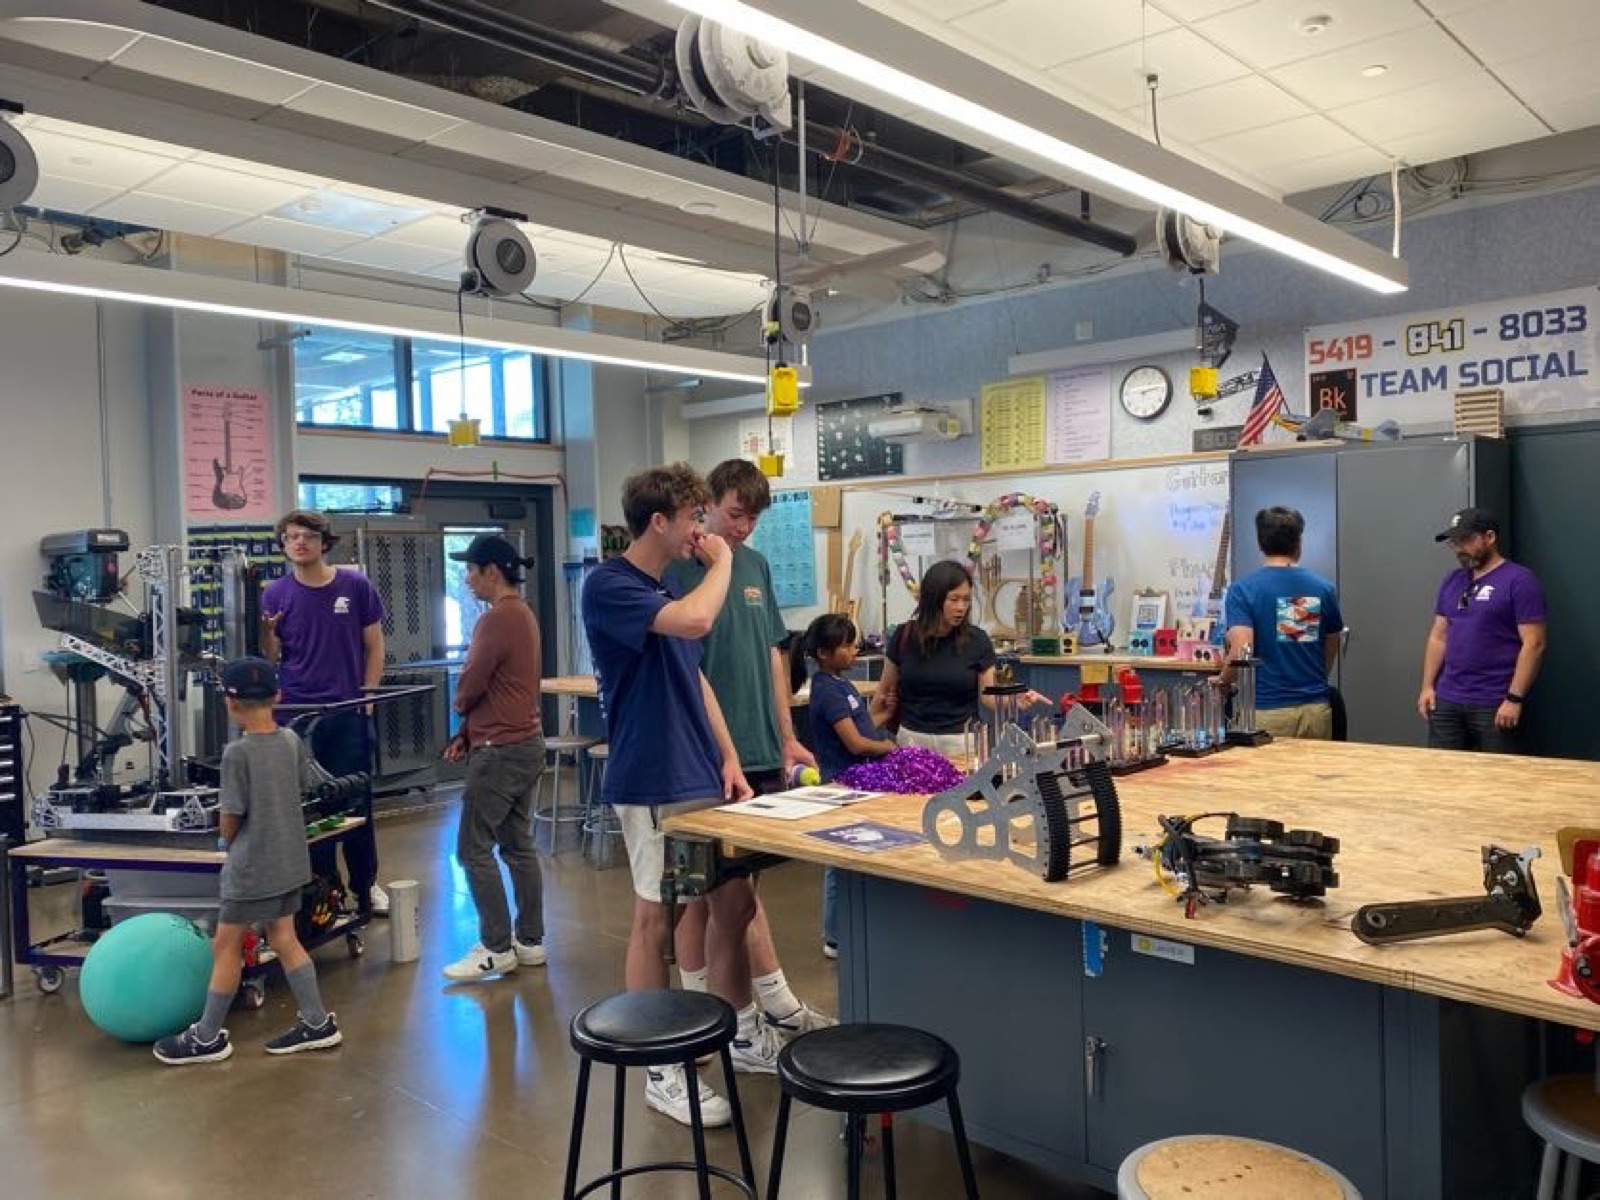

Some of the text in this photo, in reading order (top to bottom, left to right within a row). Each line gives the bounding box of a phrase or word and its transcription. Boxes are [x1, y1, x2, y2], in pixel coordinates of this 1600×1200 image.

[1309, 334, 1373, 364] 5419
[1406, 319, 1465, 356] 841
[1499, 305, 1587, 341] 8033
[1361, 350, 1589, 398] TEAM SOCIAL
[1319, 386, 1347, 410] Bk
[1201, 431, 1241, 449] 803
